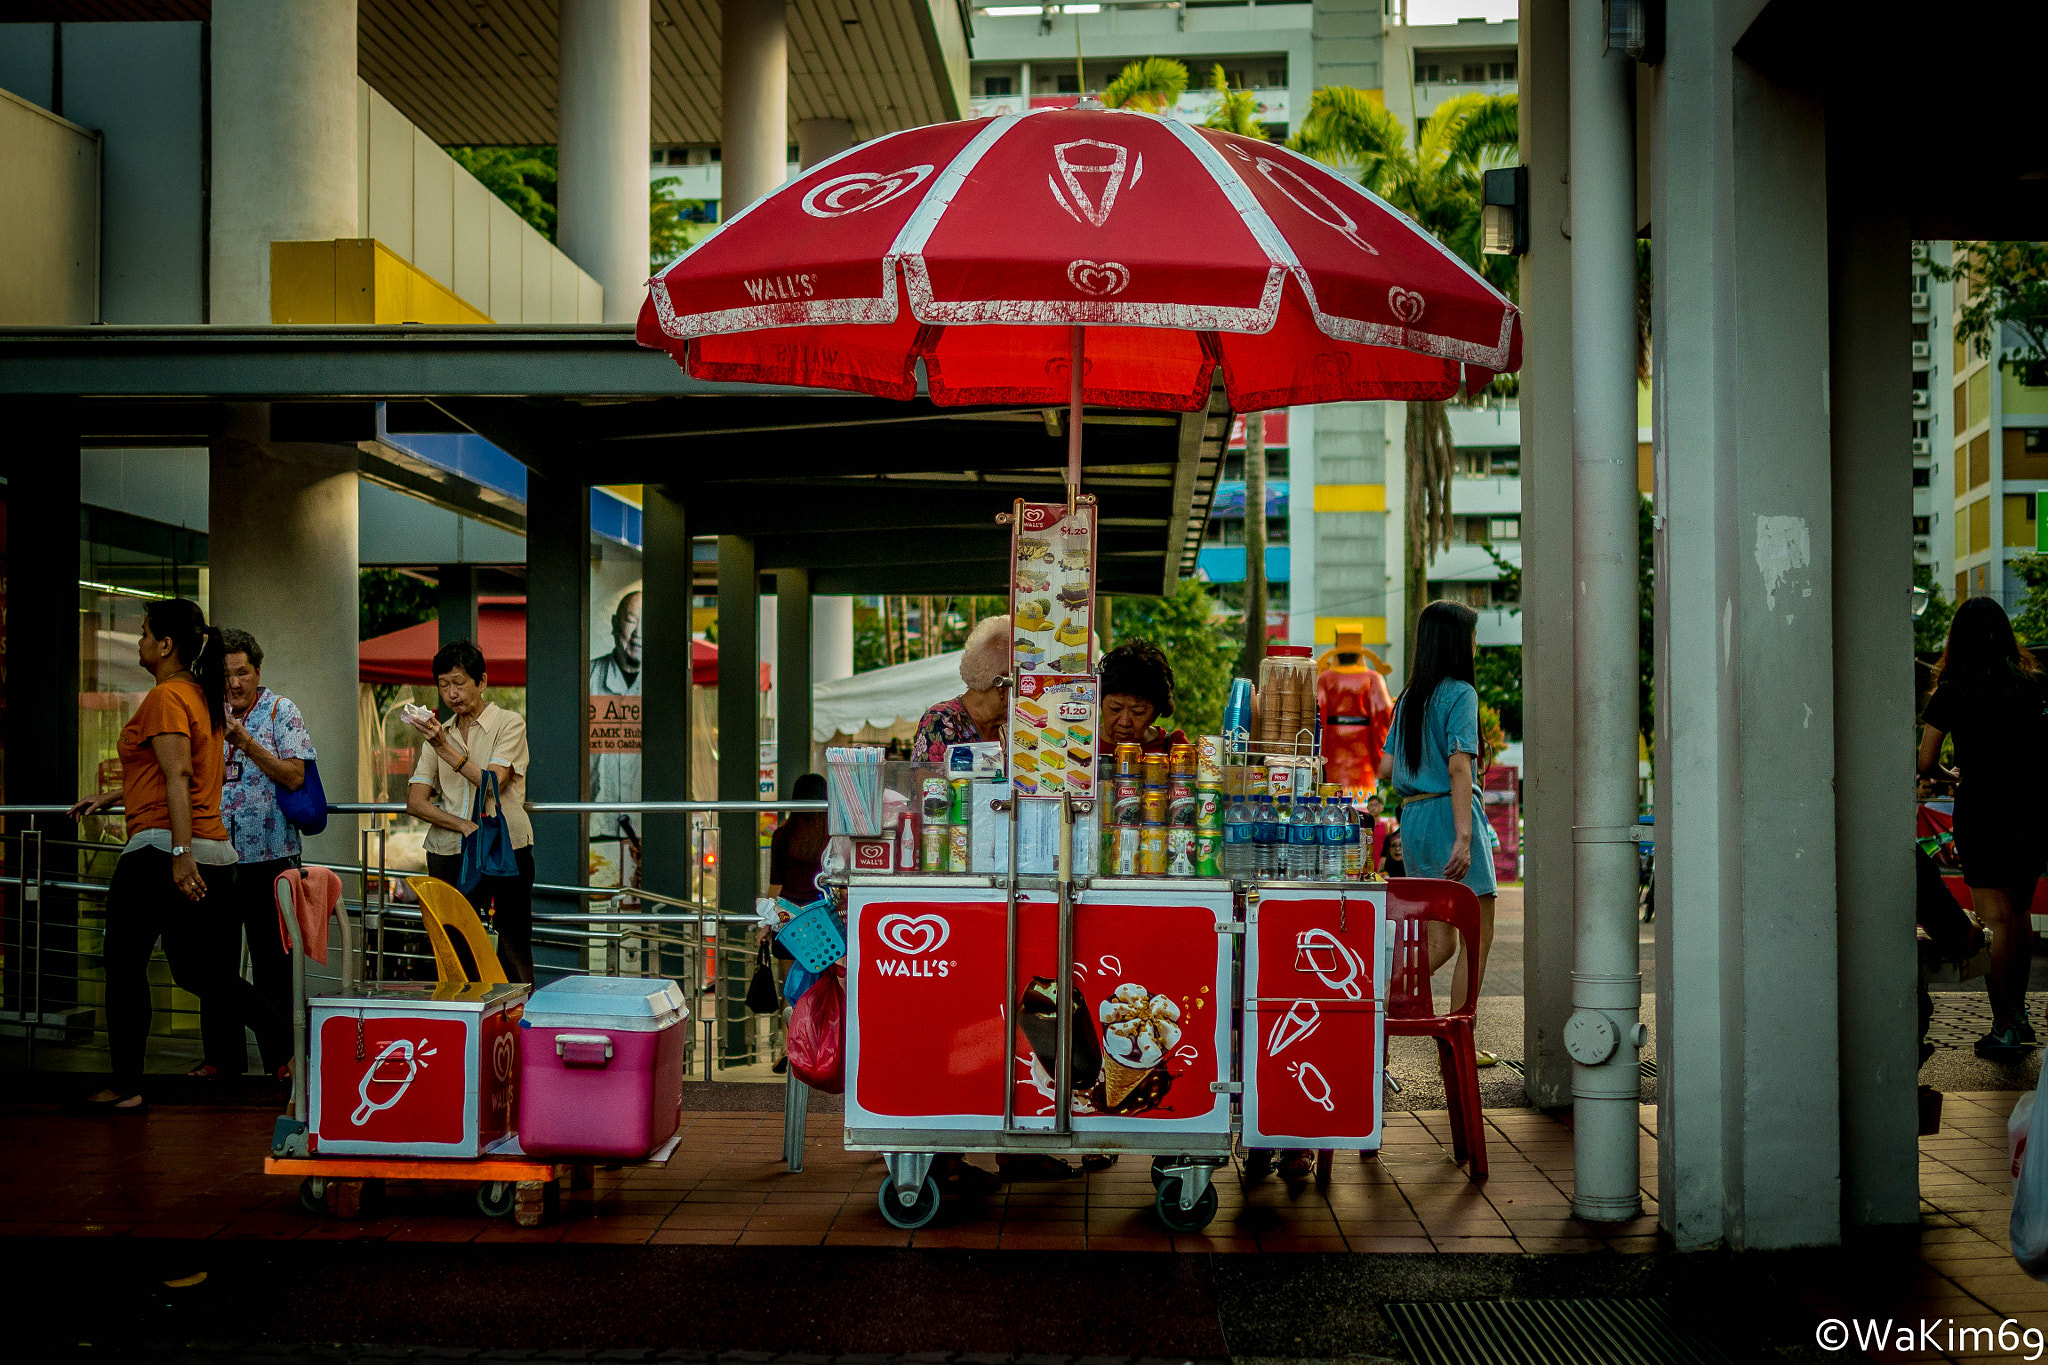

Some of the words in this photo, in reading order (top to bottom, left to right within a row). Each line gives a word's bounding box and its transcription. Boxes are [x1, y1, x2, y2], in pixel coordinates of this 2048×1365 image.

[744, 274, 813, 301] WALL'S
[1060, 526, 1088, 537] $1.20
[603, 701, 640, 720] Are
[1059, 705, 1087, 716] $1.20
[591, 728, 621, 738] AMK
[624, 728, 642, 738] Hub
[590, 740, 603, 748] xt
[605, 740, 615, 748] to
[876, 959, 949, 978] WALL'S
